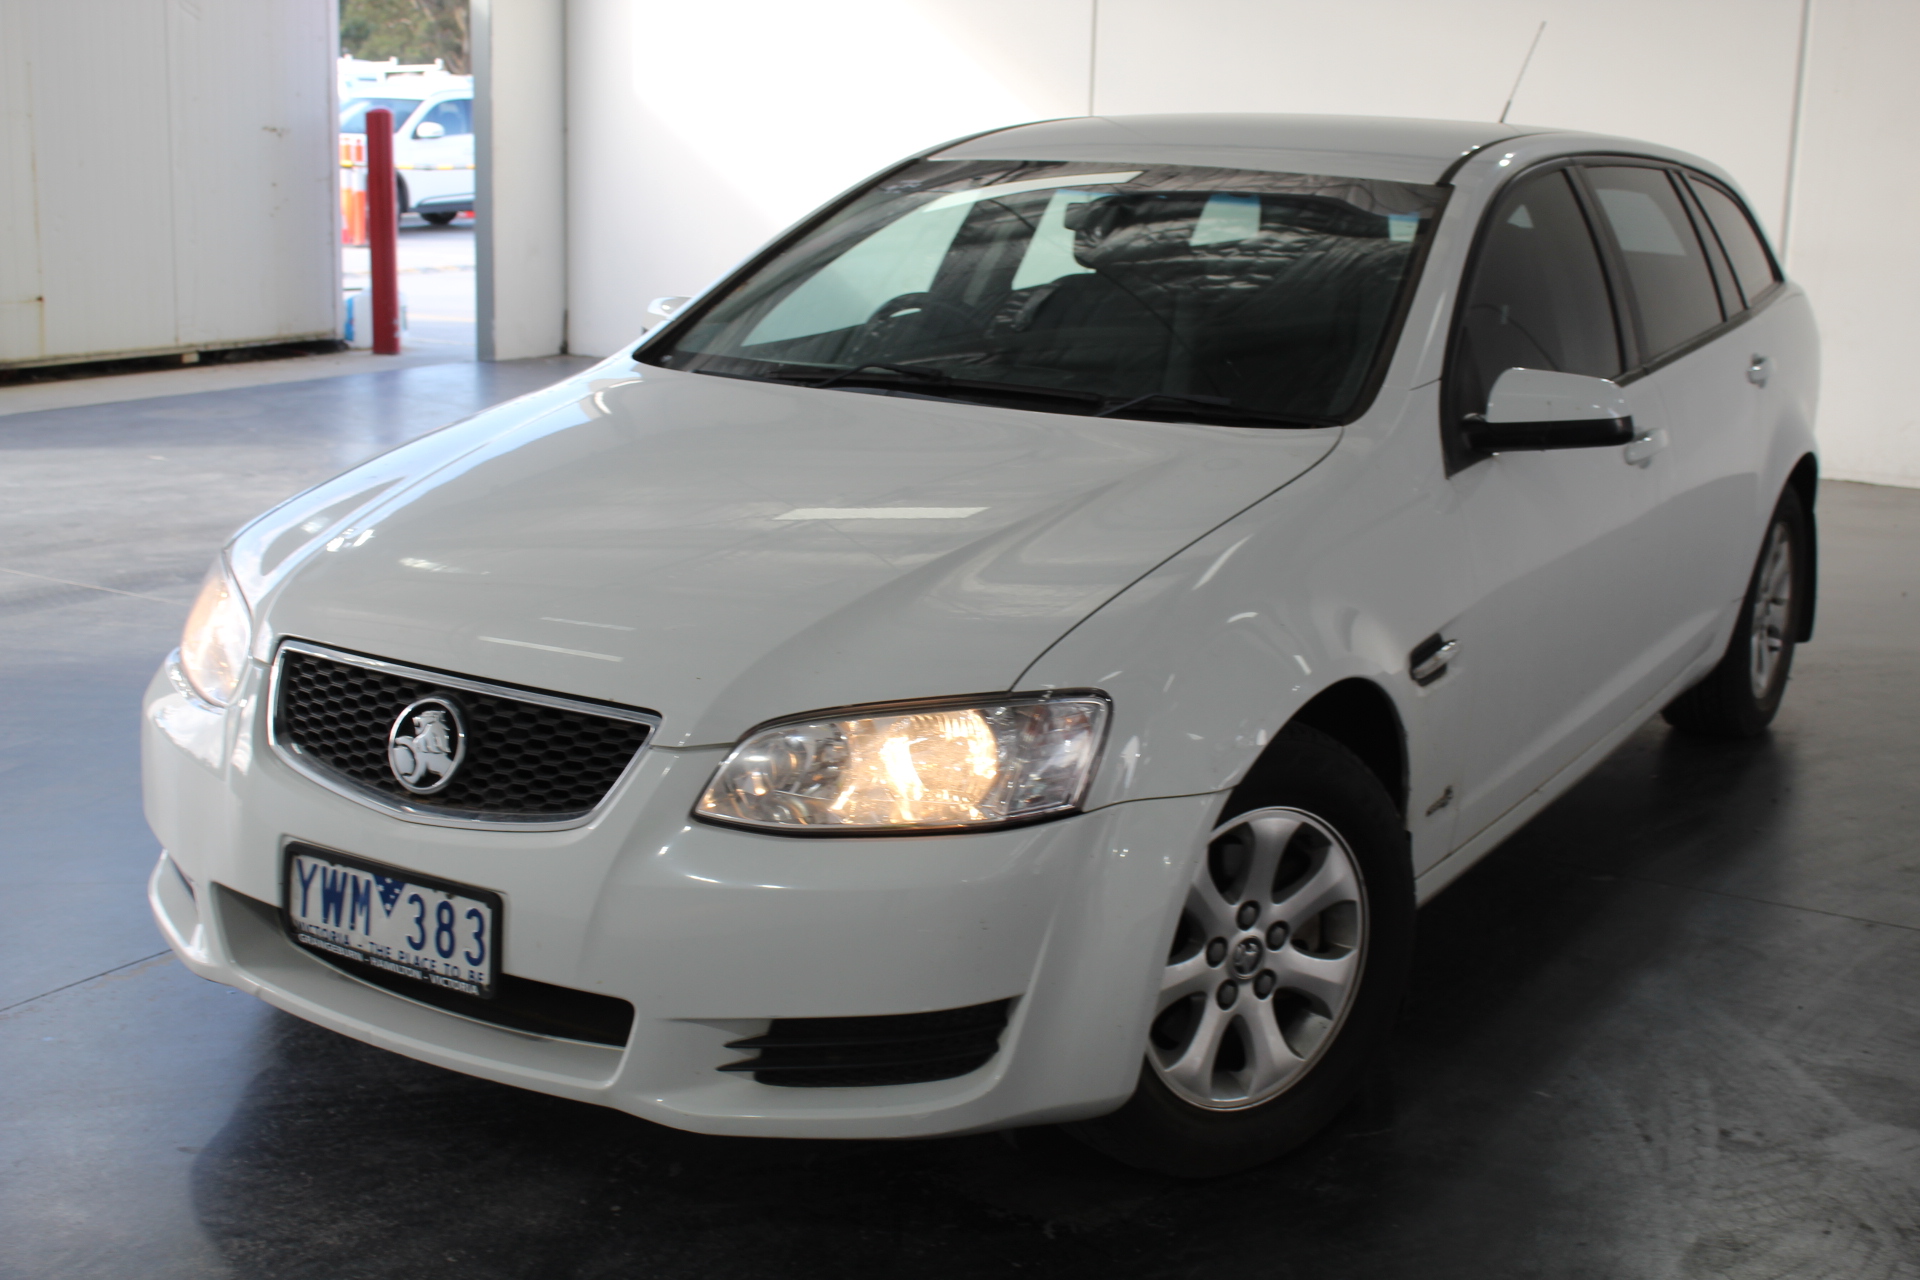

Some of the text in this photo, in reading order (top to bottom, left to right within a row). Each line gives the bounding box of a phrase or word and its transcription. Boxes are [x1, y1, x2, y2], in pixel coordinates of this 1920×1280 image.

[297, 858, 485, 967] YWM 383
[295, 919, 351, 947] VICTORIA
[368, 941, 392, 960] THE
[398, 950, 437, 974] PLACE
[444, 962, 462, 979] TO
[468, 969, 484, 985] BE
[369, 956, 423, 980] HAMILTON
[428, 973, 480, 996] VICTORIA
